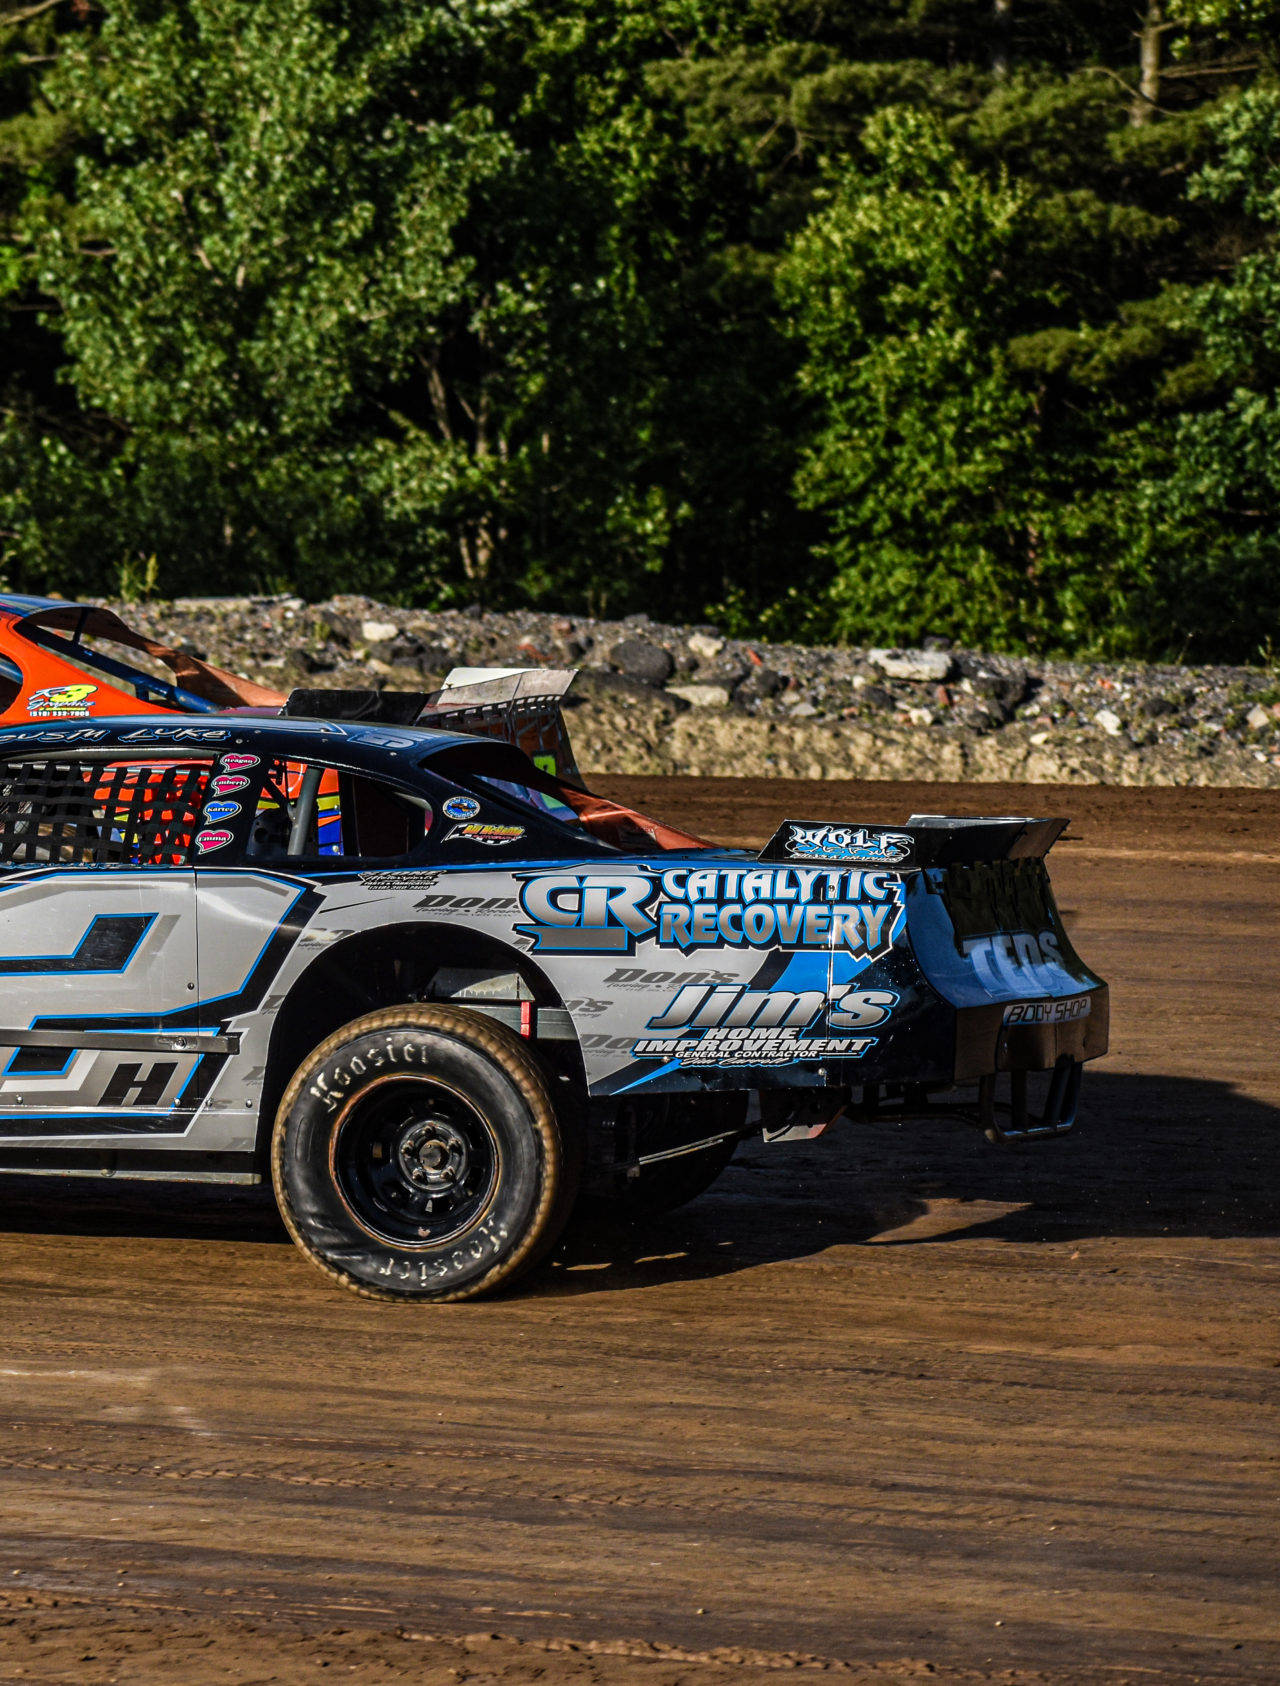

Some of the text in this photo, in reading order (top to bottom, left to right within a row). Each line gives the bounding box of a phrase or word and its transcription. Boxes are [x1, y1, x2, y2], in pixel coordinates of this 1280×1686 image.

[789, 826, 915, 849] WOLF
[661, 868, 893, 902] CATALYTIC
[659, 903, 895, 951] RECOVERY
[644, 983, 901, 1031] Jim's
[1007, 998, 1088, 1024] BODY SHOP
[634, 1038, 872, 1052] IMPROVEMENT
[703, 1027, 801, 1040] HOME
[675, 1050, 818, 1058] GENERAL CONTRACTOR
[309, 1037, 429, 1113] Hoosier
